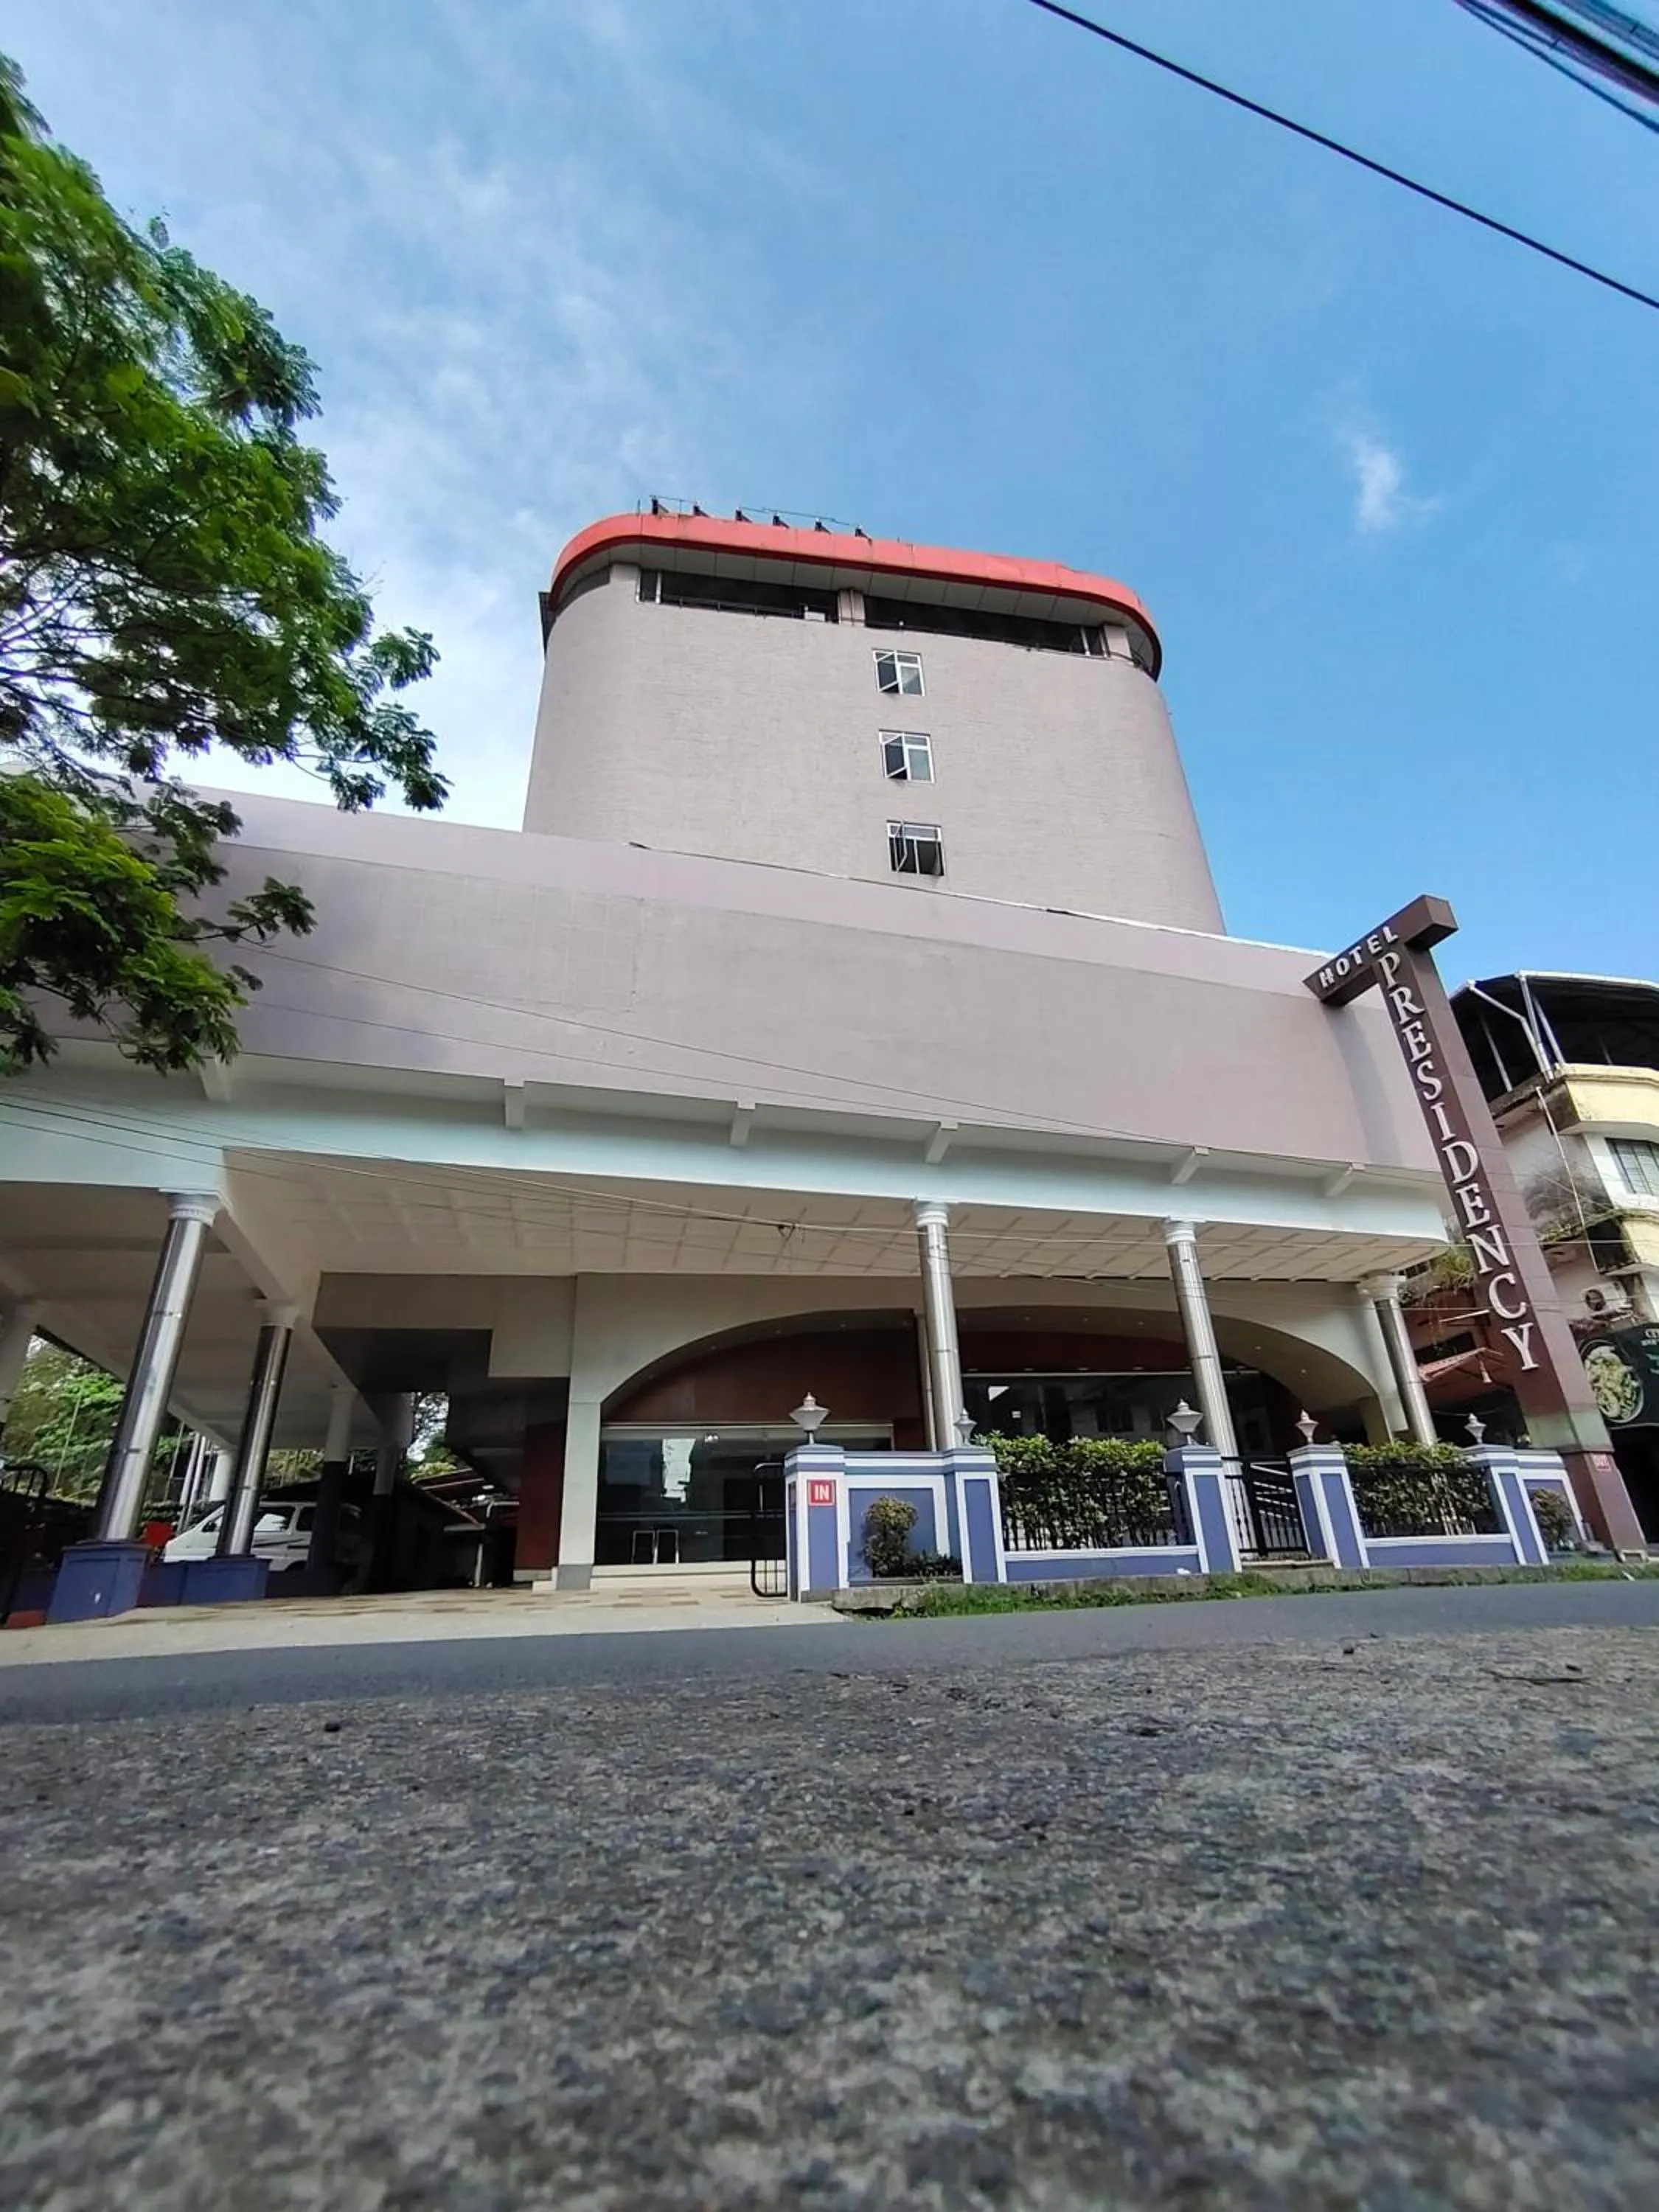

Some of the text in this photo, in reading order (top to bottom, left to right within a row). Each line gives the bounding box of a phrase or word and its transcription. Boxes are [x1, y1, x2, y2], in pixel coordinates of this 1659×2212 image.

[1319, 925, 1399, 988] HOTEL
[1377, 952, 1540, 1371] PRESIDENCY
[814, 1484, 830, 1500] IN
